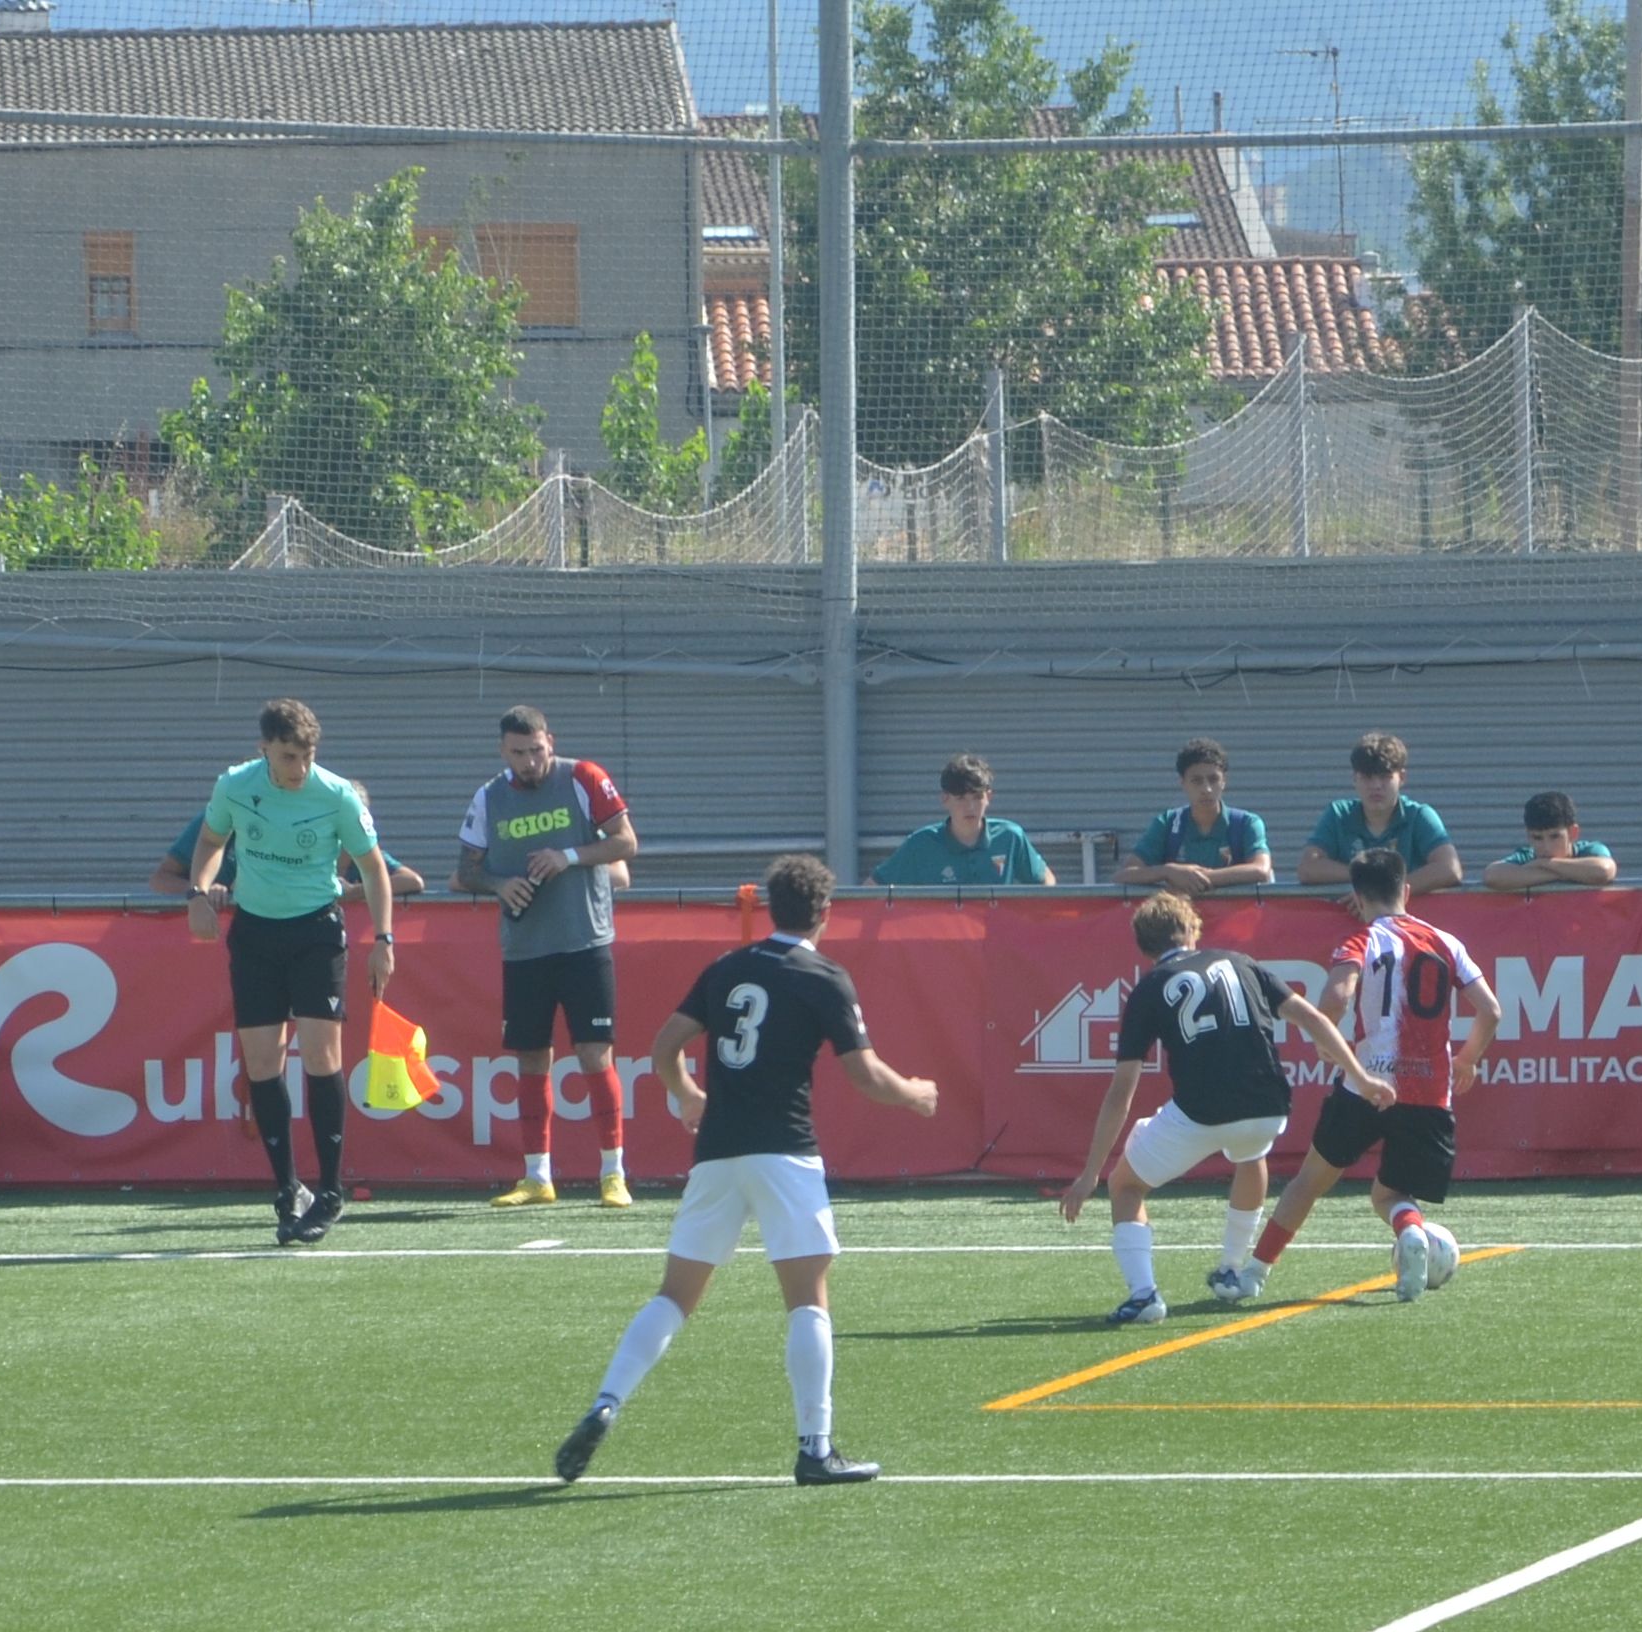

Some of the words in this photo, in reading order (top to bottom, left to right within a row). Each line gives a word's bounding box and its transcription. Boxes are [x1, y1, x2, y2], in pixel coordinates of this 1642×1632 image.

[508, 807, 572, 839] GIOS
[1163, 958, 1251, 1044] 21
[1372, 950, 1449, 1019] 10
[717, 982, 769, 1069] 3
